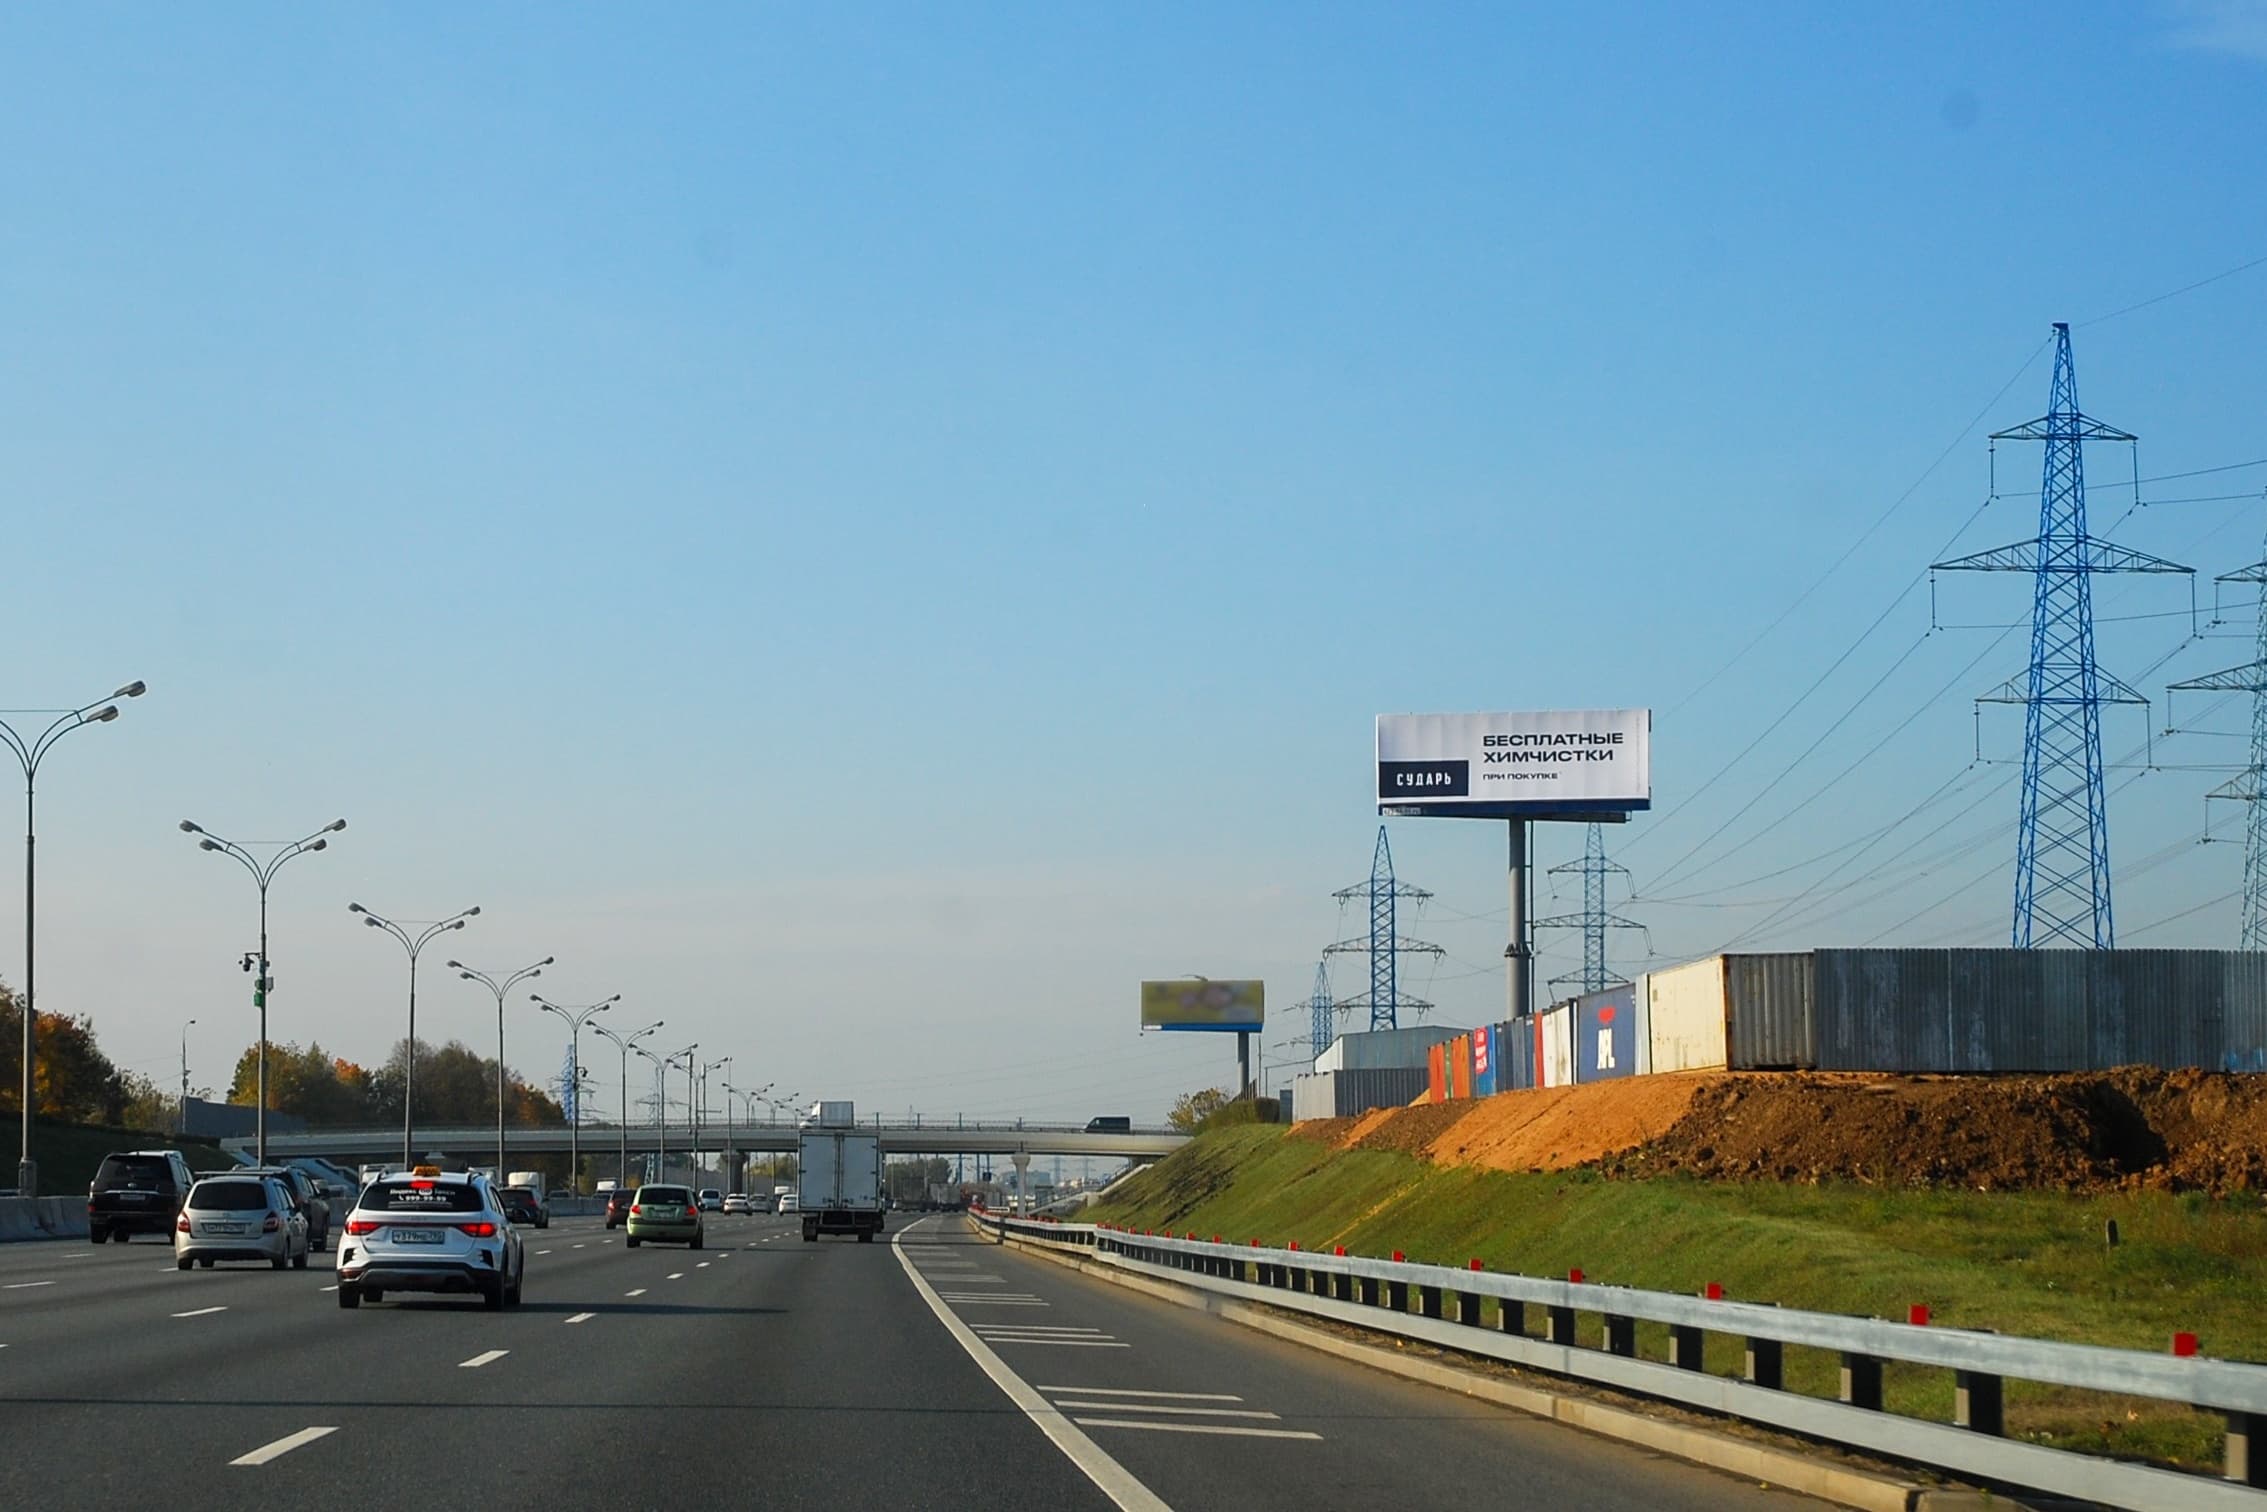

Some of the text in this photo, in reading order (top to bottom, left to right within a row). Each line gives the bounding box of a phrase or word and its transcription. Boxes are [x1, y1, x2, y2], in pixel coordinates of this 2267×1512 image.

[1483, 733, 1623, 747] БЕСПЛАТНЫЕ
[1483, 750, 1614, 763] ХИМЧИСТКИ
[1396, 772, 1452, 786] СУДАРЬ
